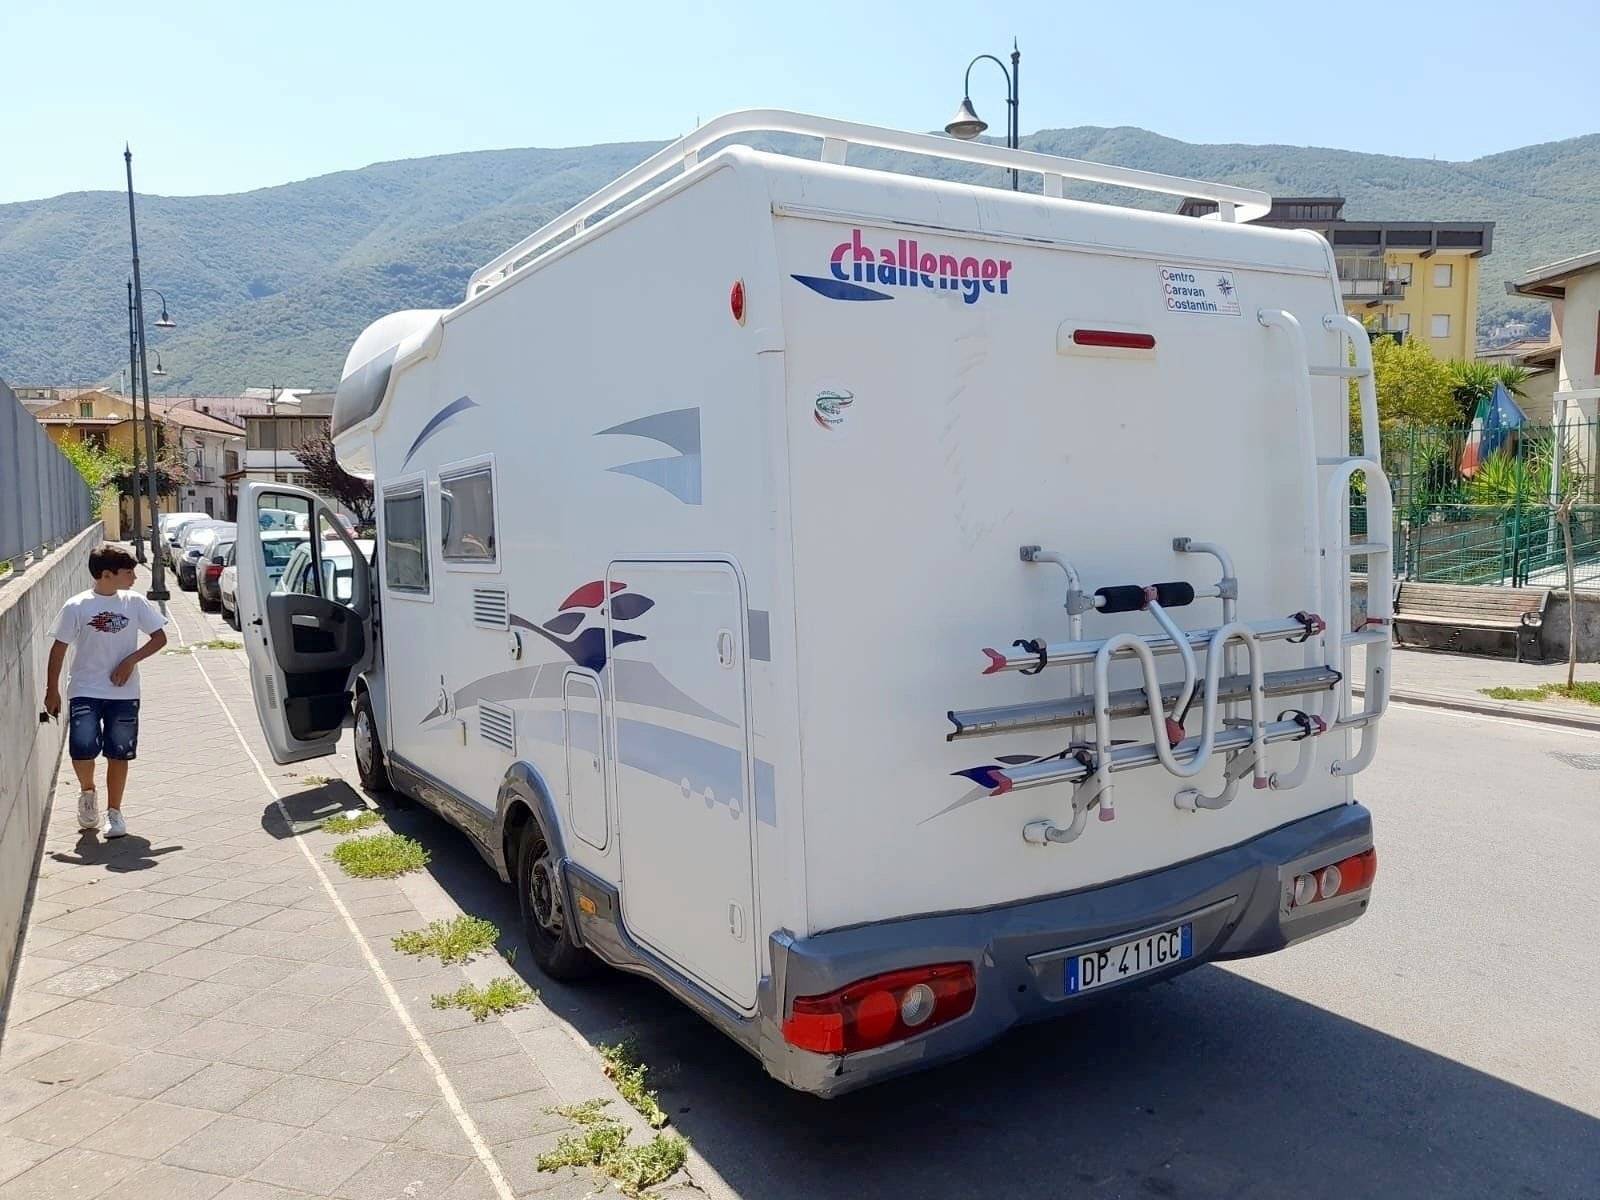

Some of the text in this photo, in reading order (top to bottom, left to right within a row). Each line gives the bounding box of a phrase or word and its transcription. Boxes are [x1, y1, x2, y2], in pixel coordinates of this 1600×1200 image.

[830, 229, 1012, 304] challenger
[1161, 269, 1195, 283] Centro
[1165, 283, 1206, 297] Caravan
[1167, 297, 1218, 312] Costantini
[1083, 934, 1179, 986] DP 411GC
